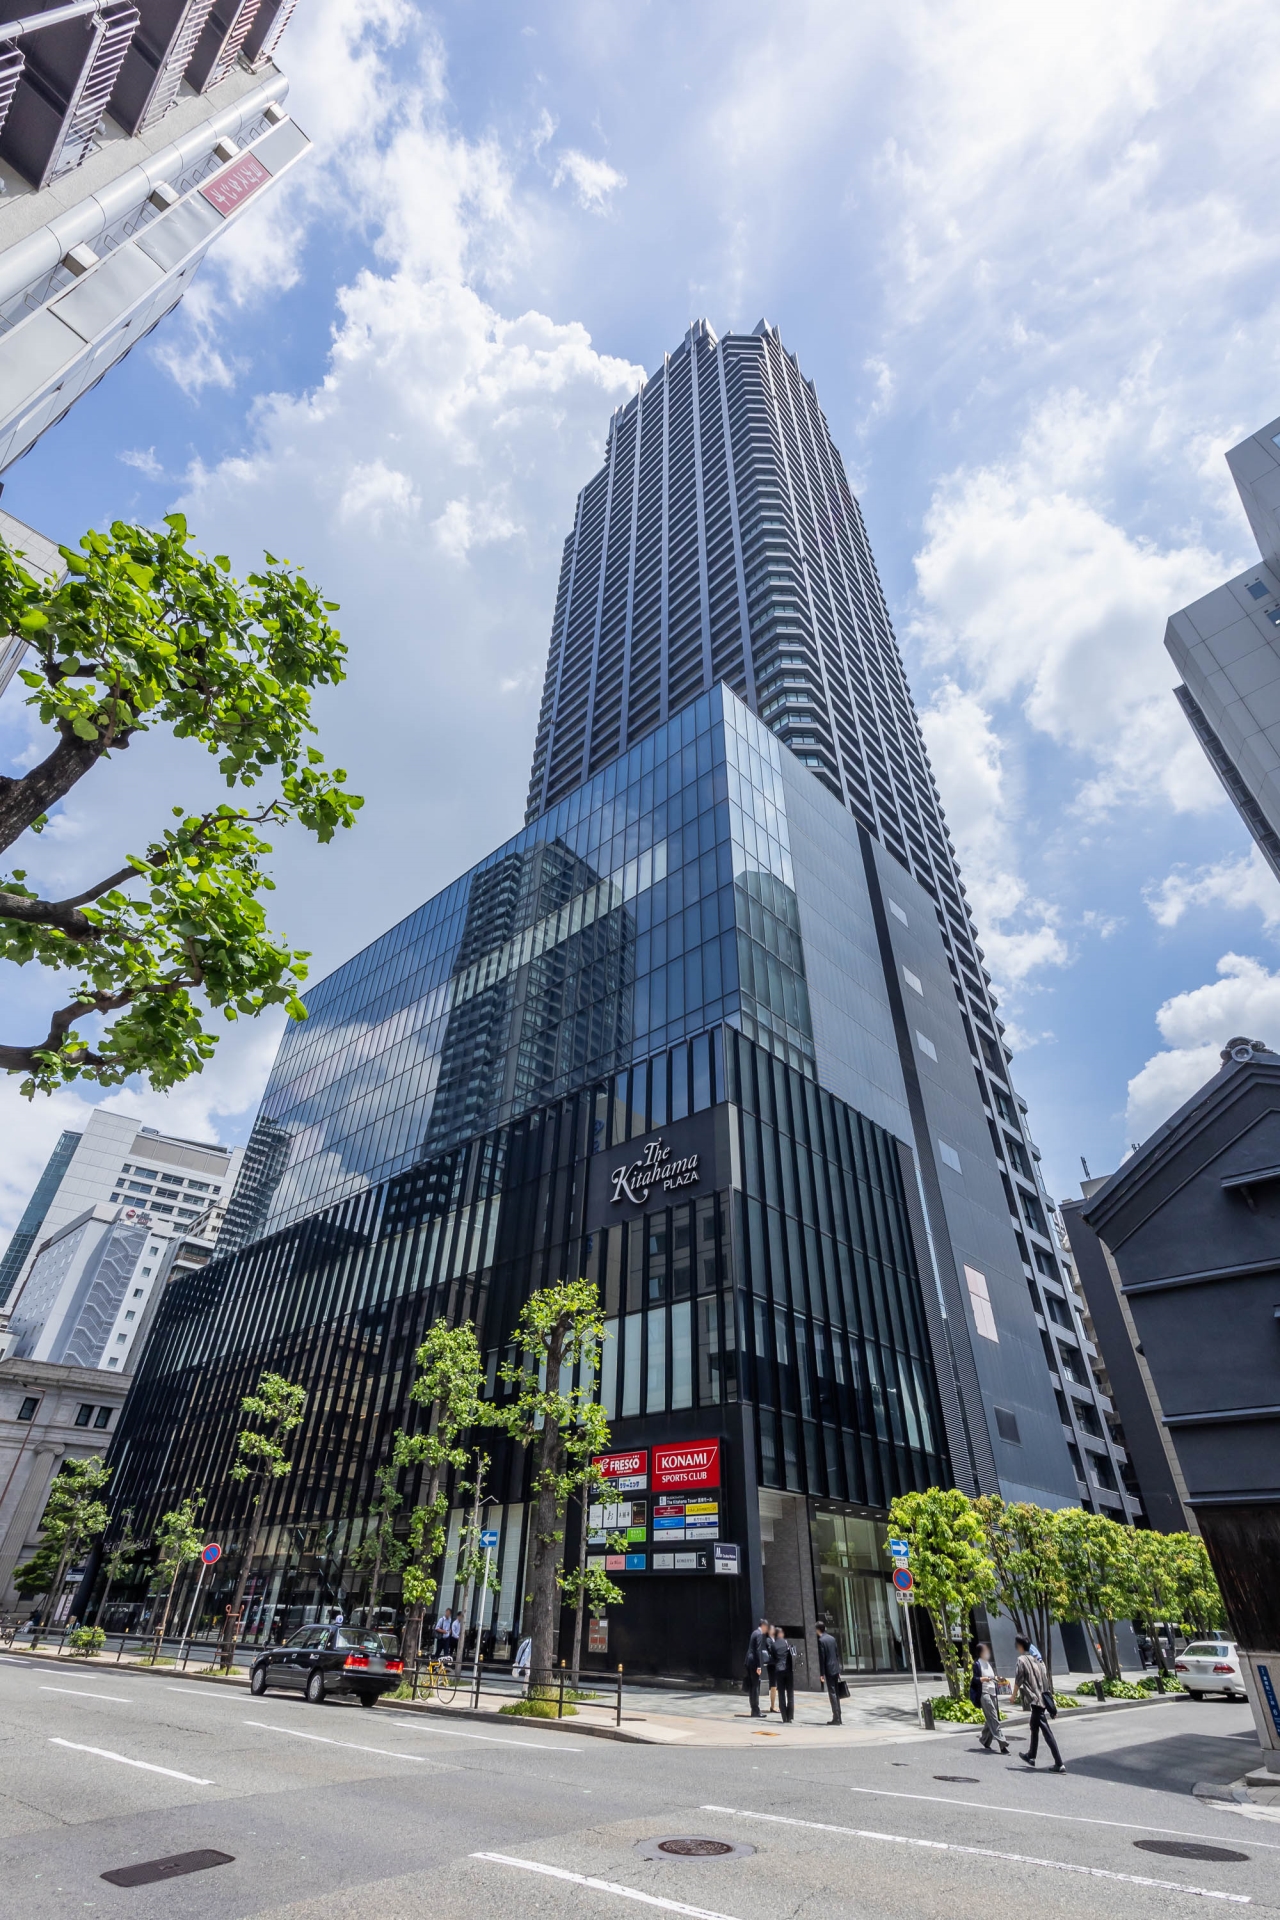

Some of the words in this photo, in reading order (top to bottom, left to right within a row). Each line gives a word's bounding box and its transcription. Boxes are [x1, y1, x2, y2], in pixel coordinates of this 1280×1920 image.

[210, 161, 263, 207] ヨガスタジオ
[643, 1137, 671, 1167] The
[609, 1153, 698, 1204] Kitahama
[663, 1170, 699, 1191] PLAZA
[610, 1458, 640, 1472] FRESCO
[661, 1452, 707, 1469] KONAMI
[661, 1473, 688, 1483] SPORTS
[688, 1471, 707, 1481] CLUB
